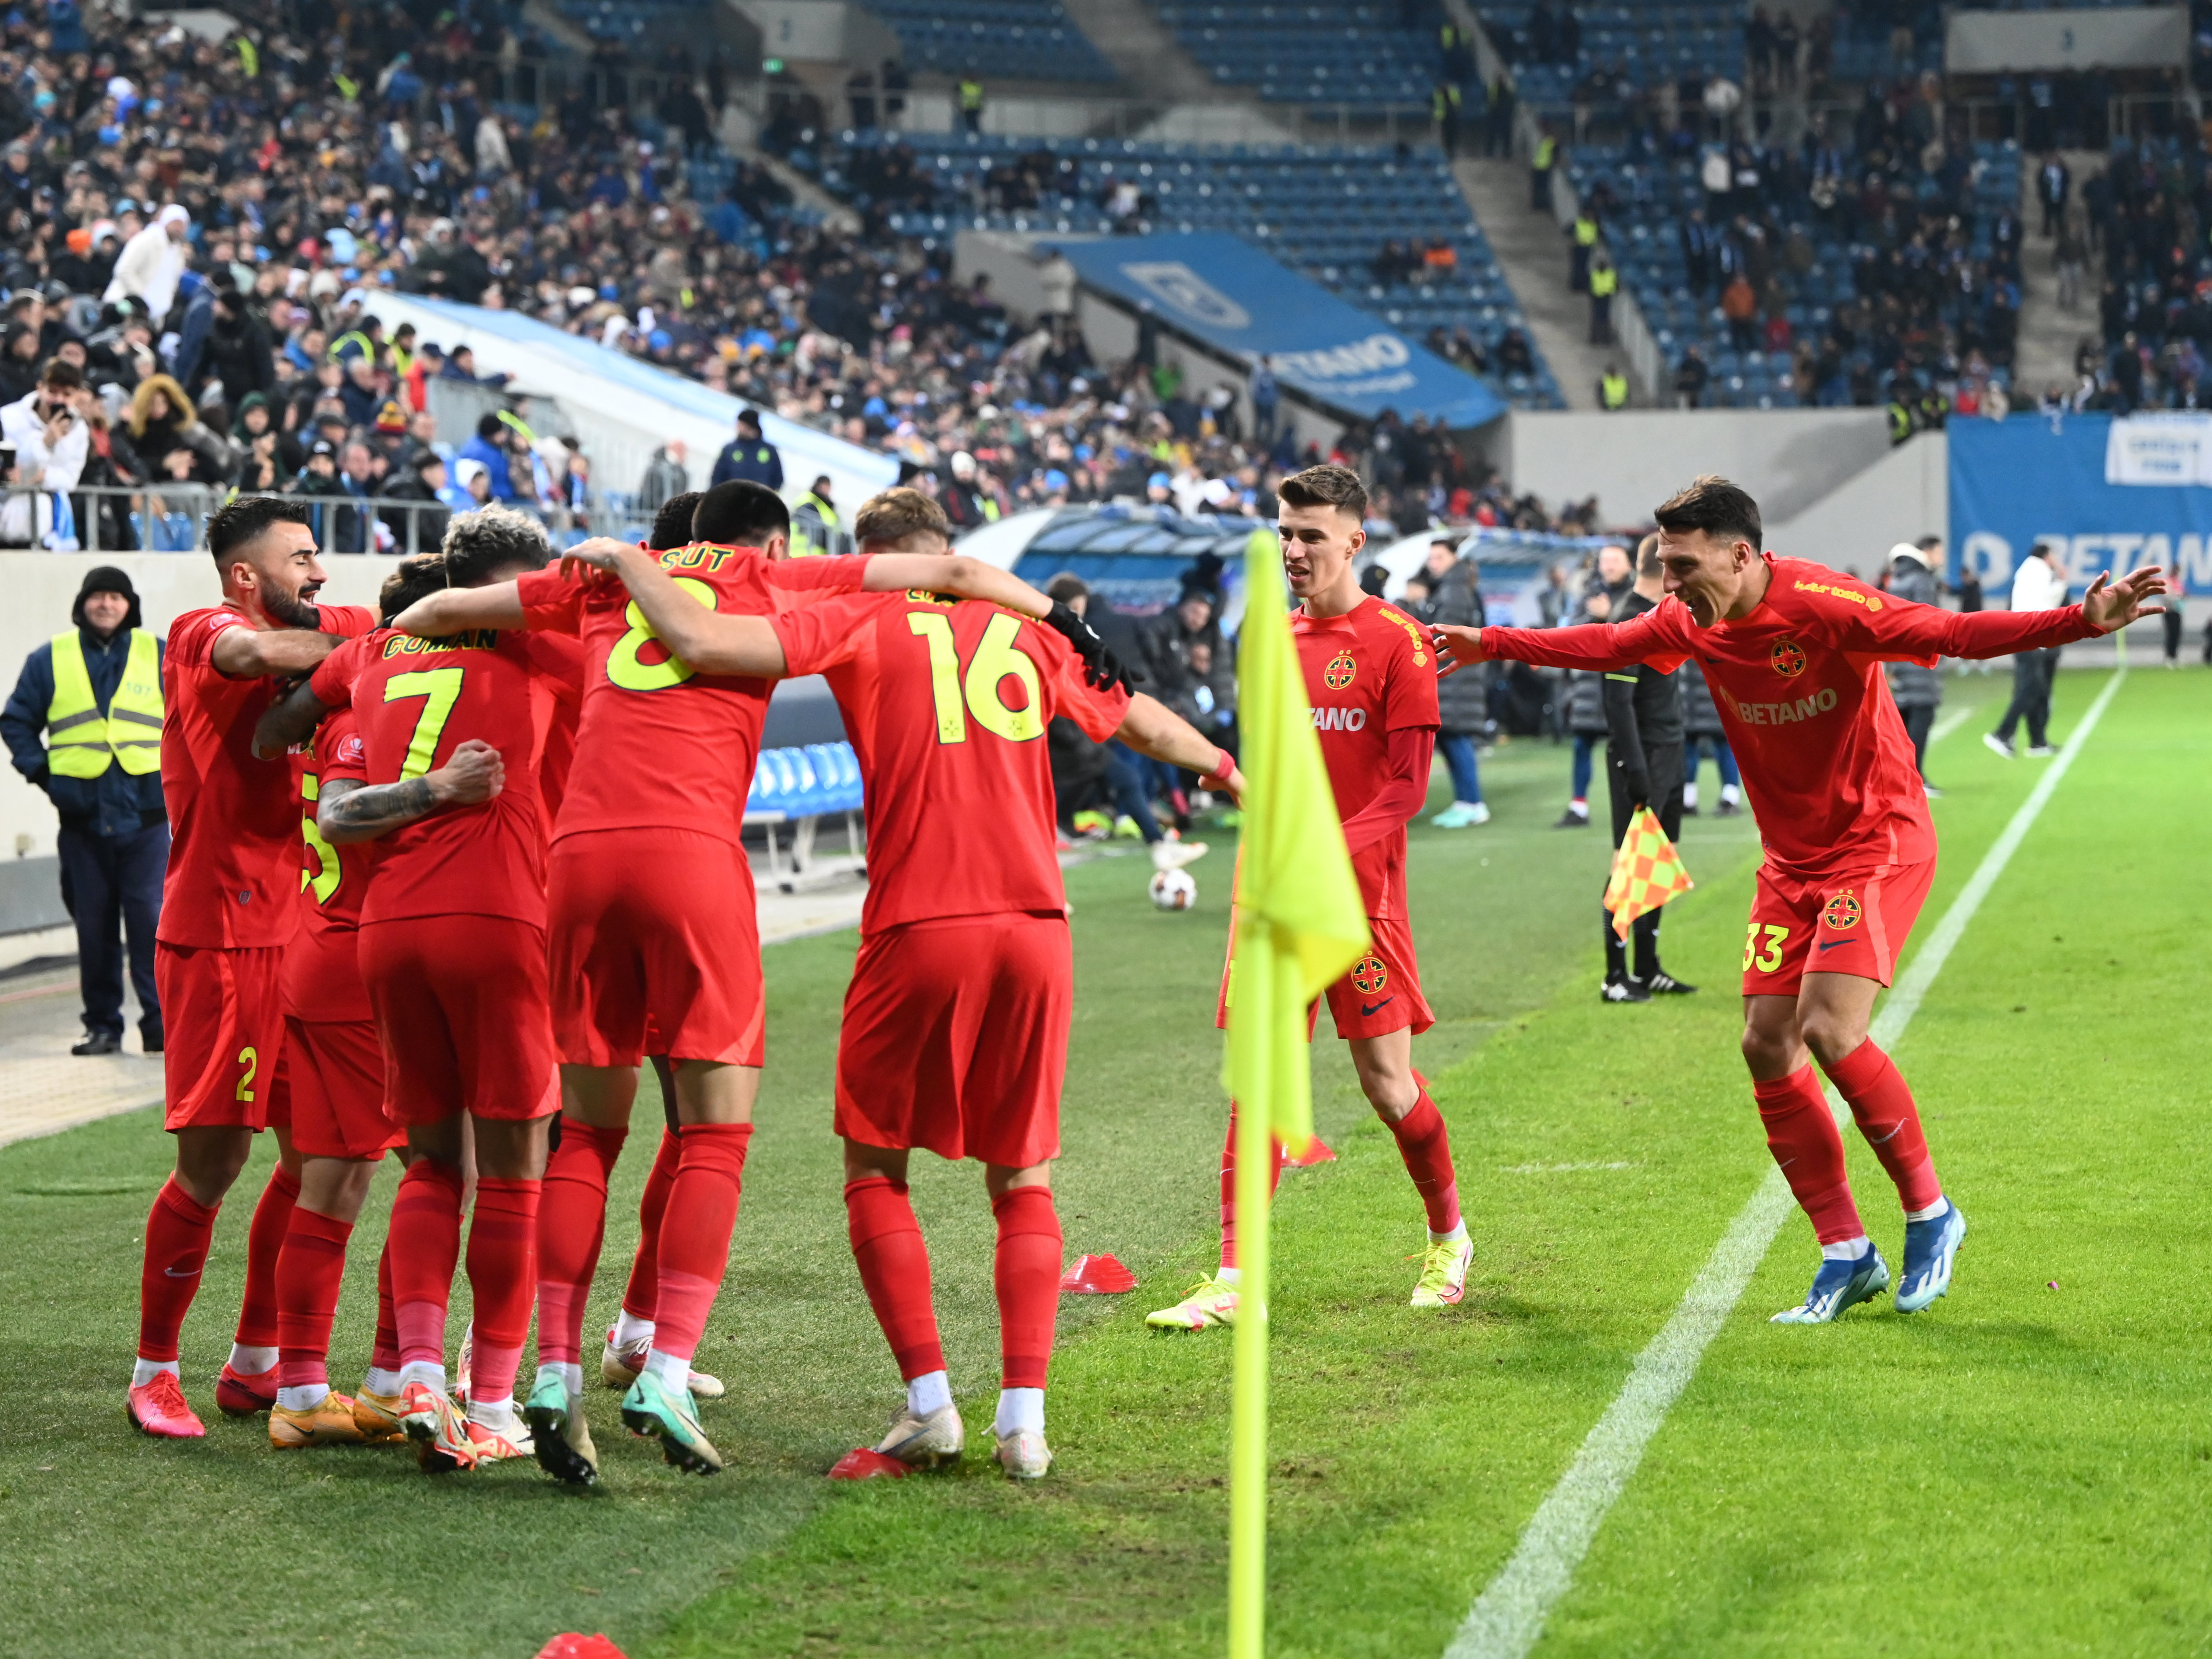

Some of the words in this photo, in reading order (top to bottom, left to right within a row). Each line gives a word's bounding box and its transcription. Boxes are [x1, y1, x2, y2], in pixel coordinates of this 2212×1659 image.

[659, 546, 735, 572] SUT
[1378, 607, 1408, 625] walter
[1831, 586, 1865, 604] tosto
[607, 576, 718, 692] 8
[907, 612, 1044, 745] 16
[383, 667, 465, 782] 7
[1738, 688, 1837, 724] BETANO
[1742, 923, 1789, 973] 33
[236, 1047, 257, 1102] 2
